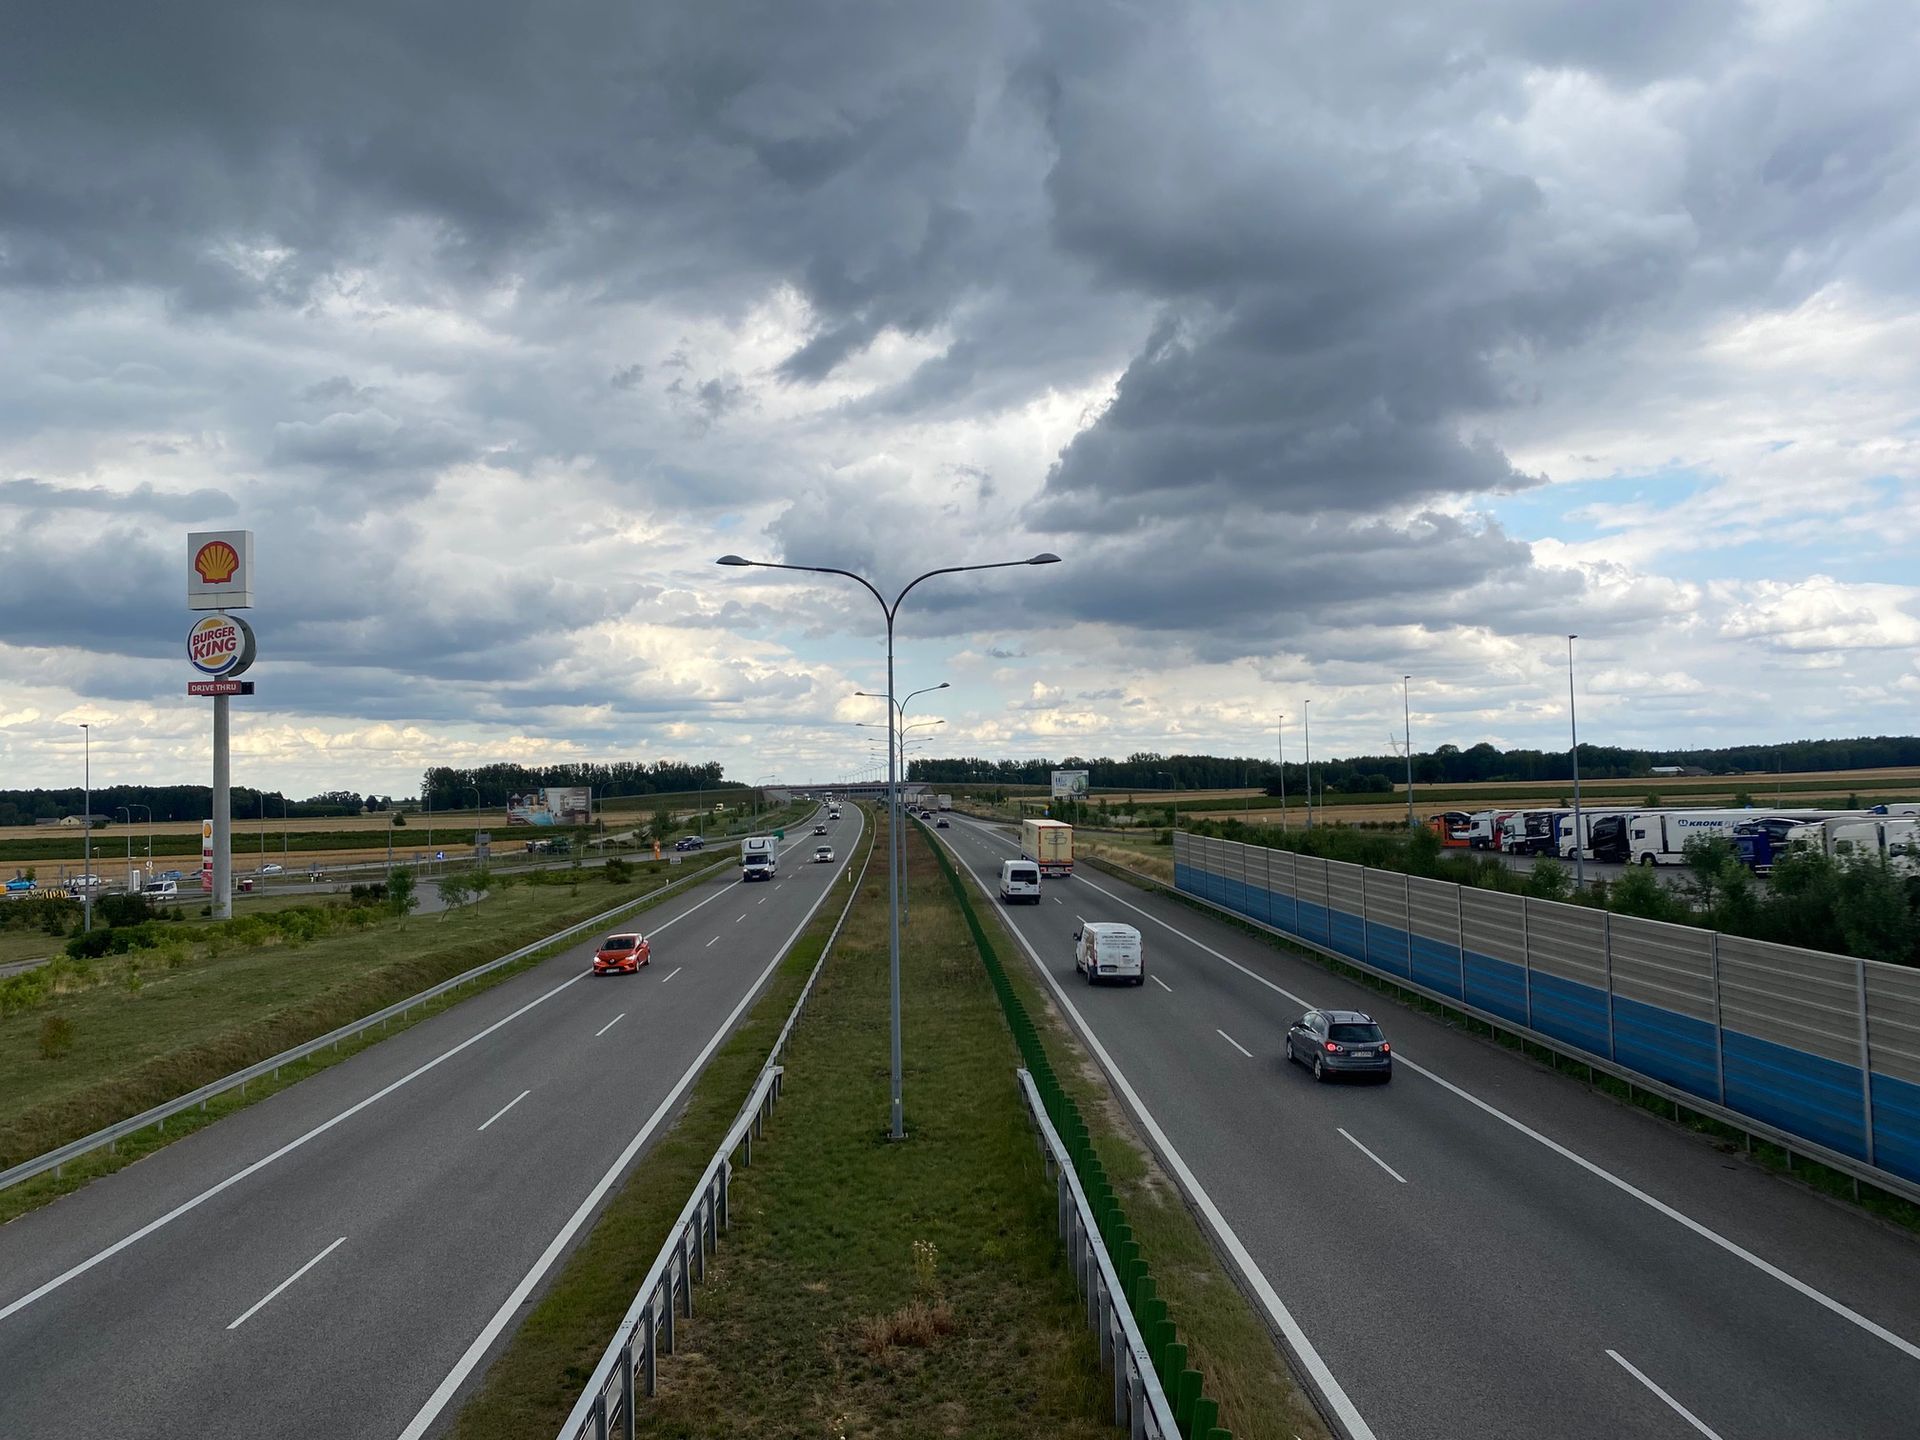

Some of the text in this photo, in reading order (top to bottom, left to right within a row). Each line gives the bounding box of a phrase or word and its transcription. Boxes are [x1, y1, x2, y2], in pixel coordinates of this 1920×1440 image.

[193, 626, 235, 646] BURGER
[193, 637, 237, 660] KING
[191, 683, 237, 692] DRIVE THRU
